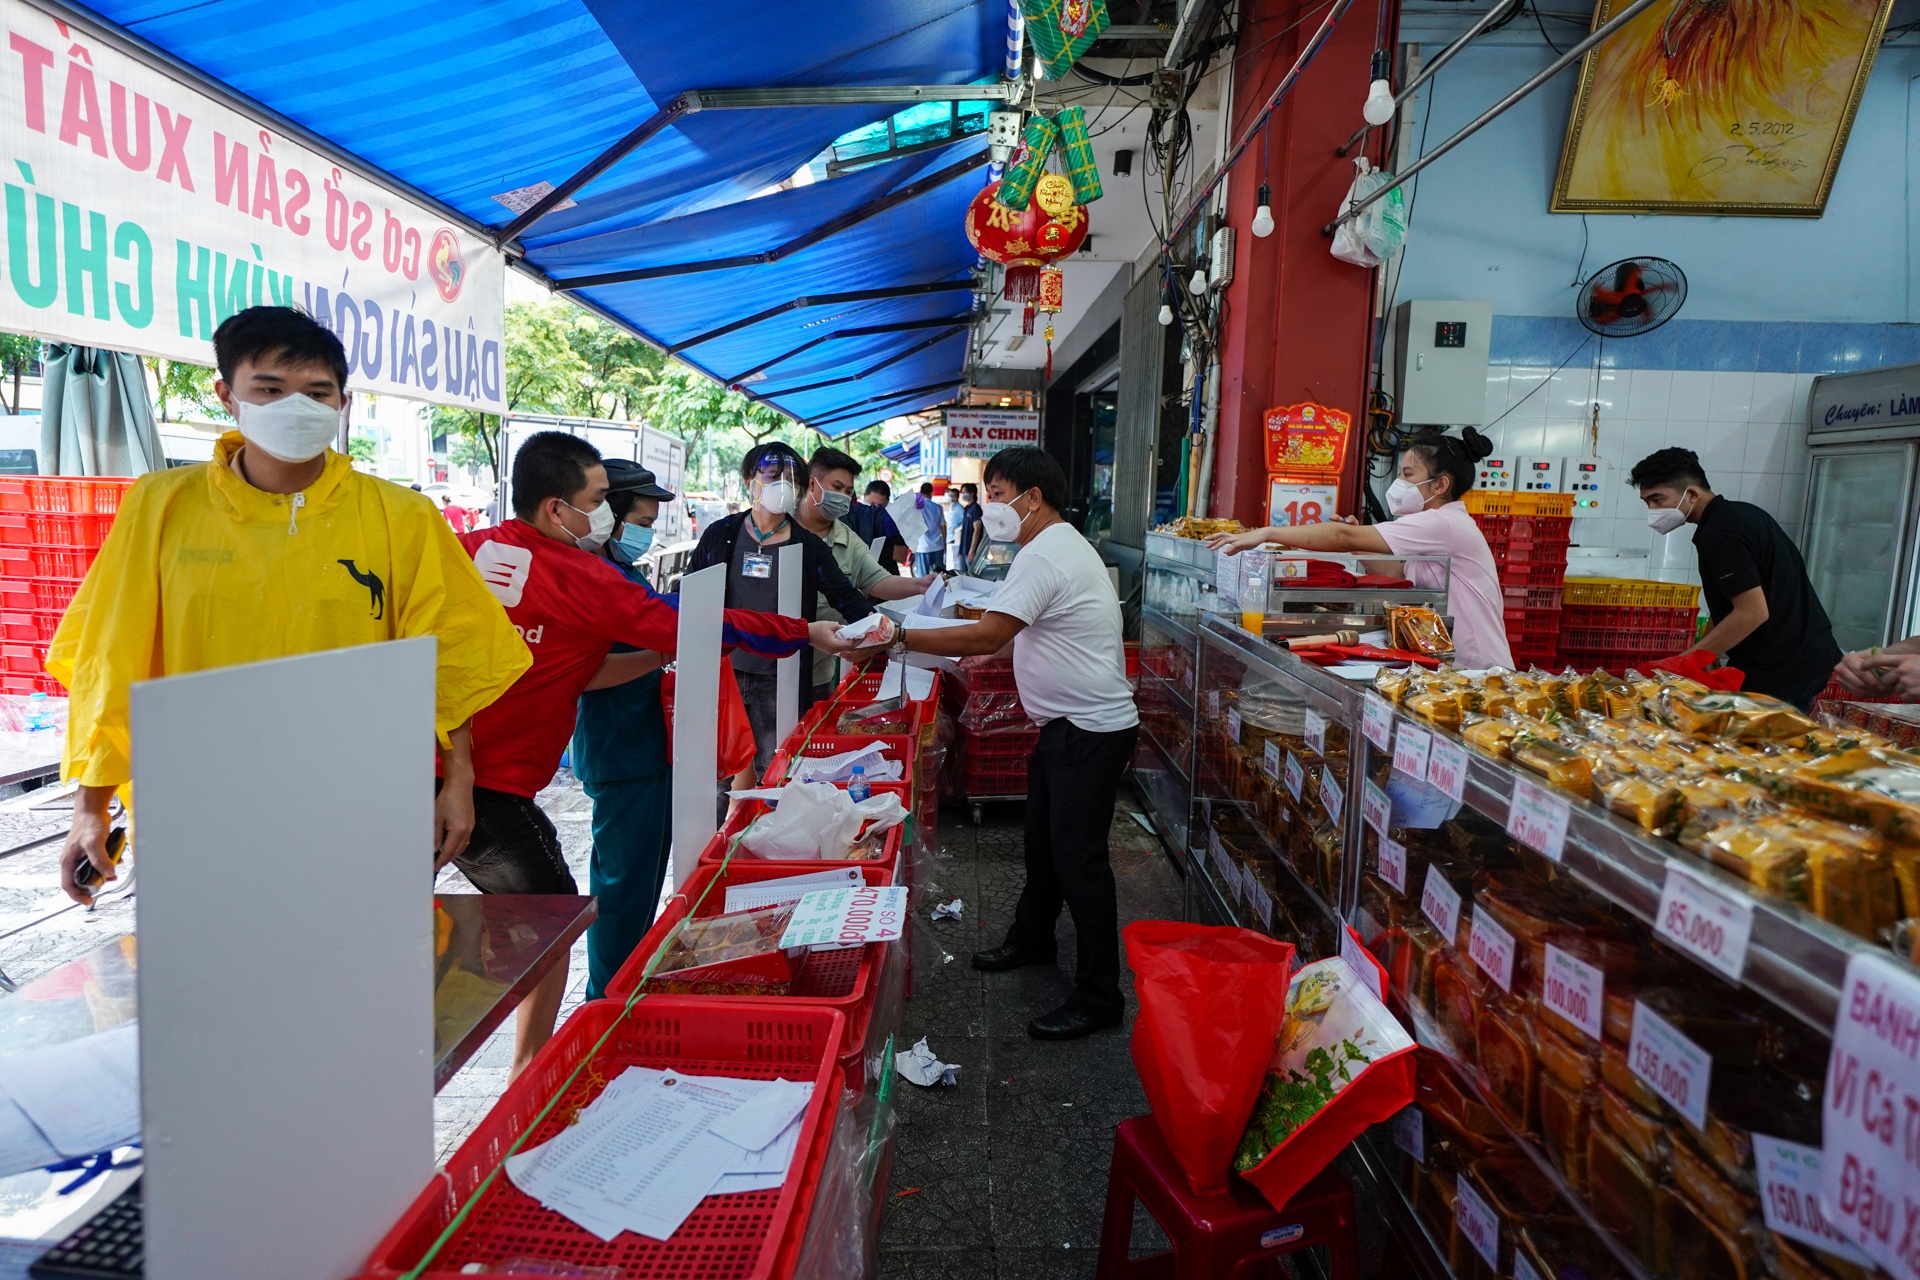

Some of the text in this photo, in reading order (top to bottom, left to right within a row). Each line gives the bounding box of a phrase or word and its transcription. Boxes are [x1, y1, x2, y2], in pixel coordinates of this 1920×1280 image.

[950, 426, 1038, 441] LAN CHINH
[1824, 402, 1881, 426] Chuyên:
[1284, 501, 1322, 527] 18
[1512, 815, 1547, 852] 85.000
[839, 887, 880, 942] 470.000đ
[876, 928, 898, 938] 4
[1666, 900, 1725, 957] 85.000
[1472, 932, 1503, 978] 100.000
[1546, 975, 1588, 1025] 100.000
[1635, 1040, 1690, 1107] 135.000
